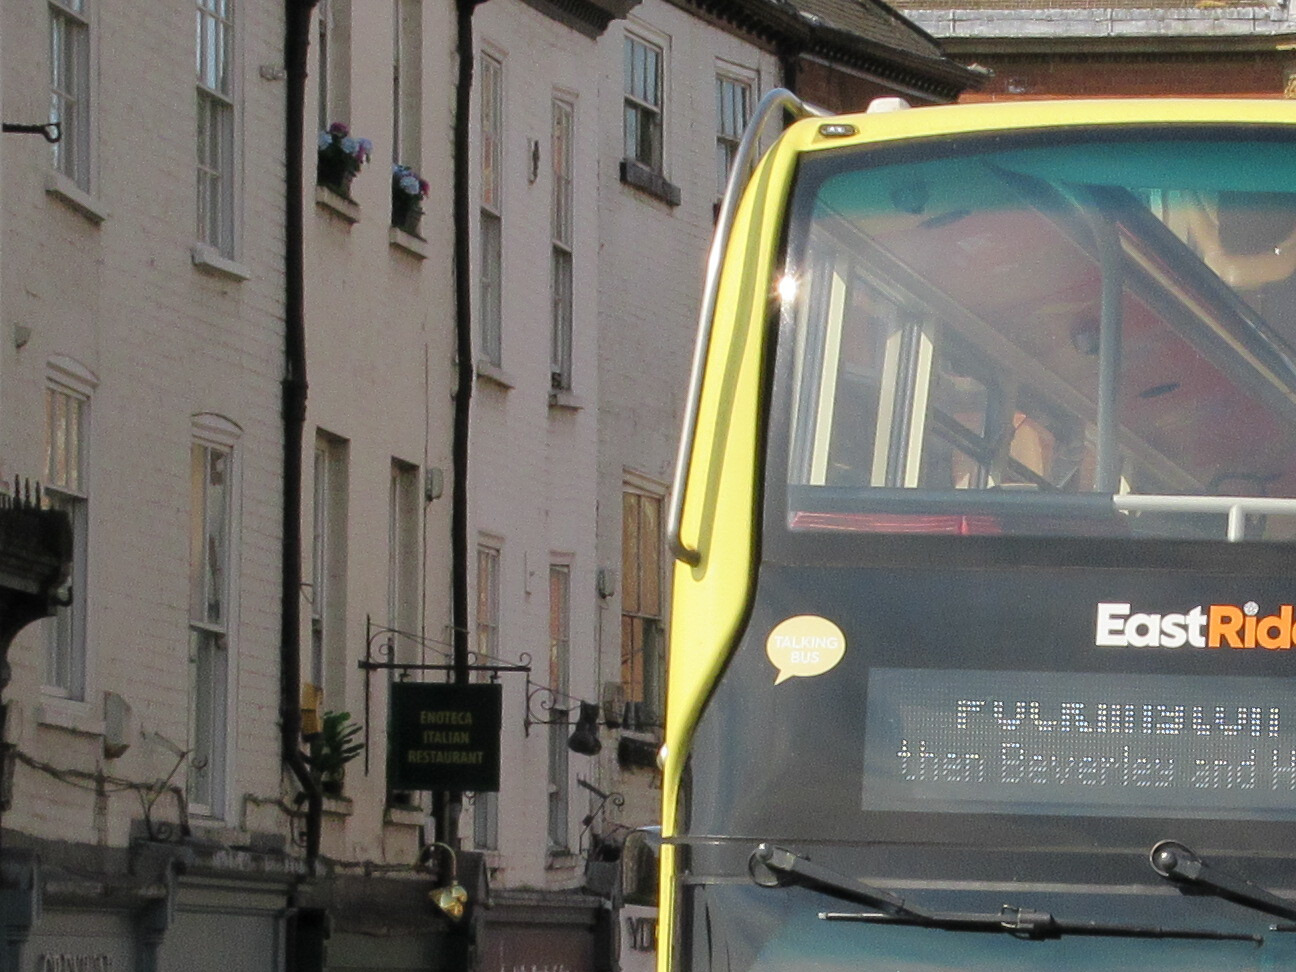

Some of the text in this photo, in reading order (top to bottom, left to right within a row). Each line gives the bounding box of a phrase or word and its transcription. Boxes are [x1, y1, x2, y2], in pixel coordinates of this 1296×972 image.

[774, 636, 838, 649] TALKING
[791, 651, 820, 663] BUS
[420, 711, 472, 724] ENOTECA
[423, 731, 470, 743] ITALIAN
[408, 751, 483, 764] RESTAURANT
[897, 740, 984, 782] then
[1001, 742, 1175, 786] Beverley
[1191, 748, 1256, 789] and
